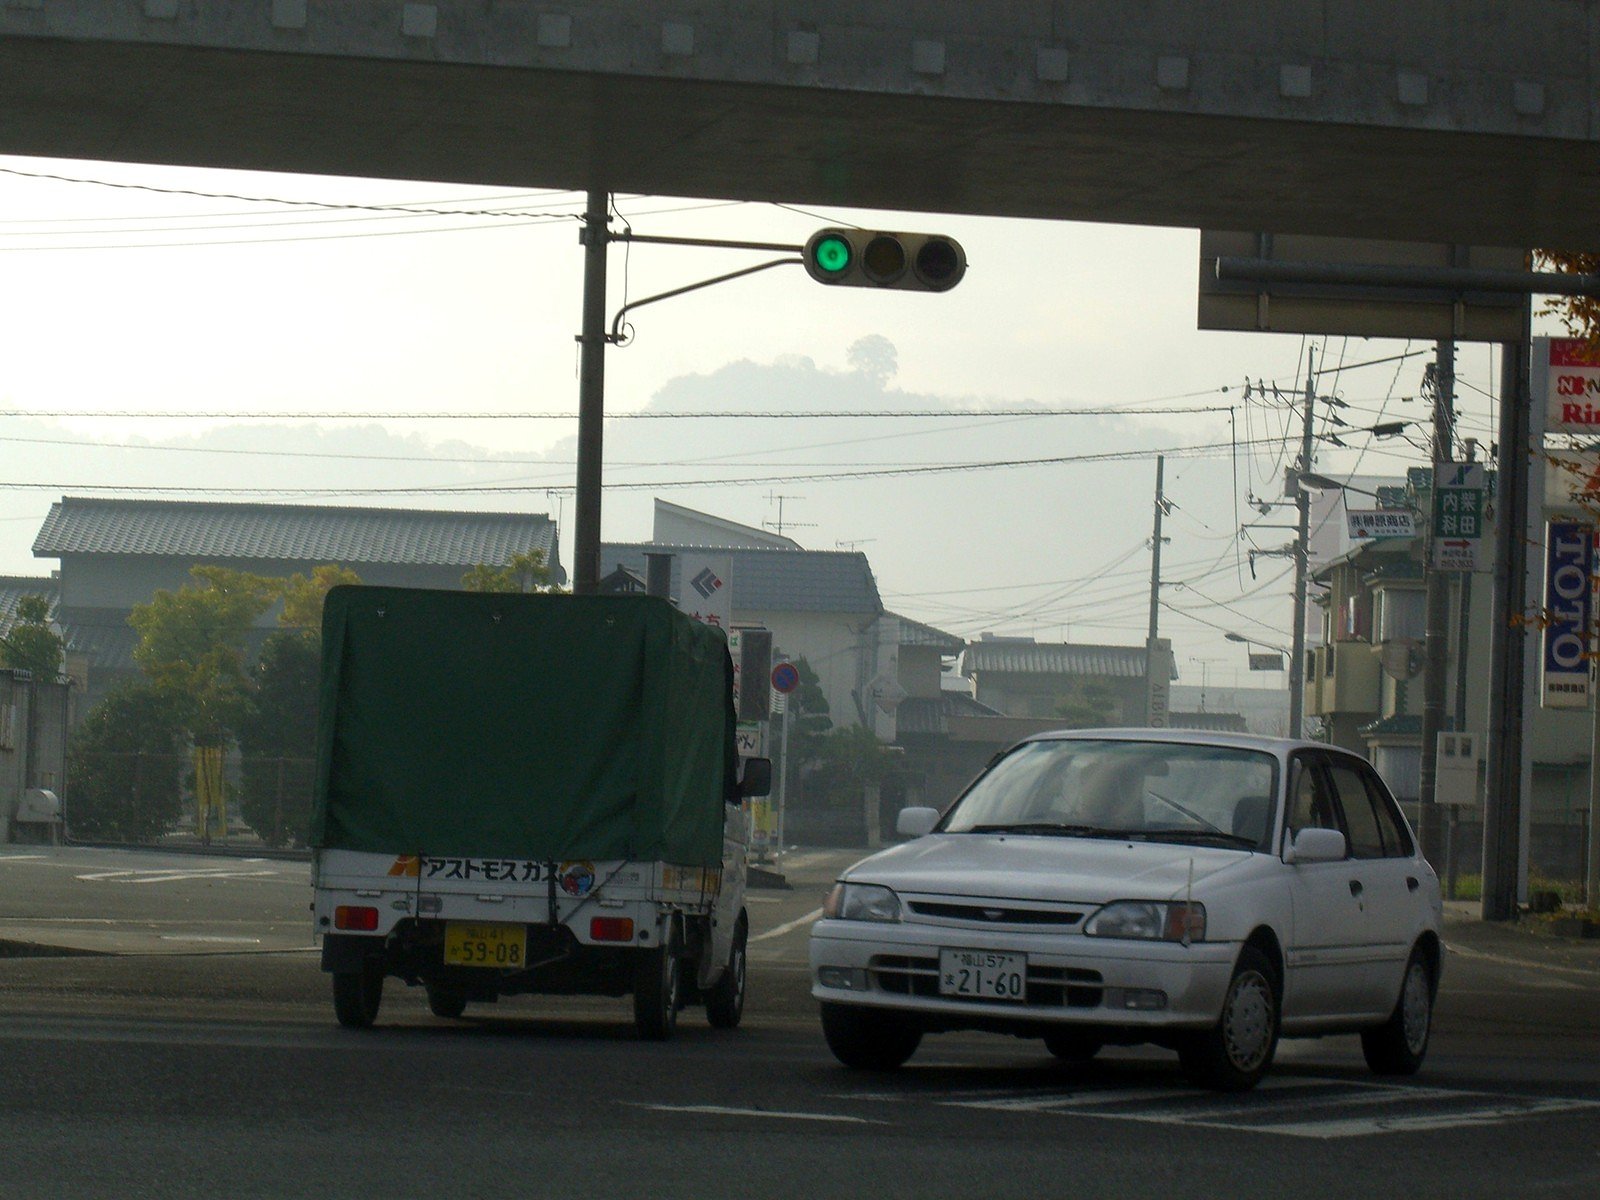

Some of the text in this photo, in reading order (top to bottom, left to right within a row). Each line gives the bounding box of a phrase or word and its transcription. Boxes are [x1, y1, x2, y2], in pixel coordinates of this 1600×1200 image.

[1551, 532, 1587, 668] TOTO
[427, 858, 517, 881] アストモス
[463, 941, 520, 963] 59-08
[958, 969, 1022, 995] 21-60
